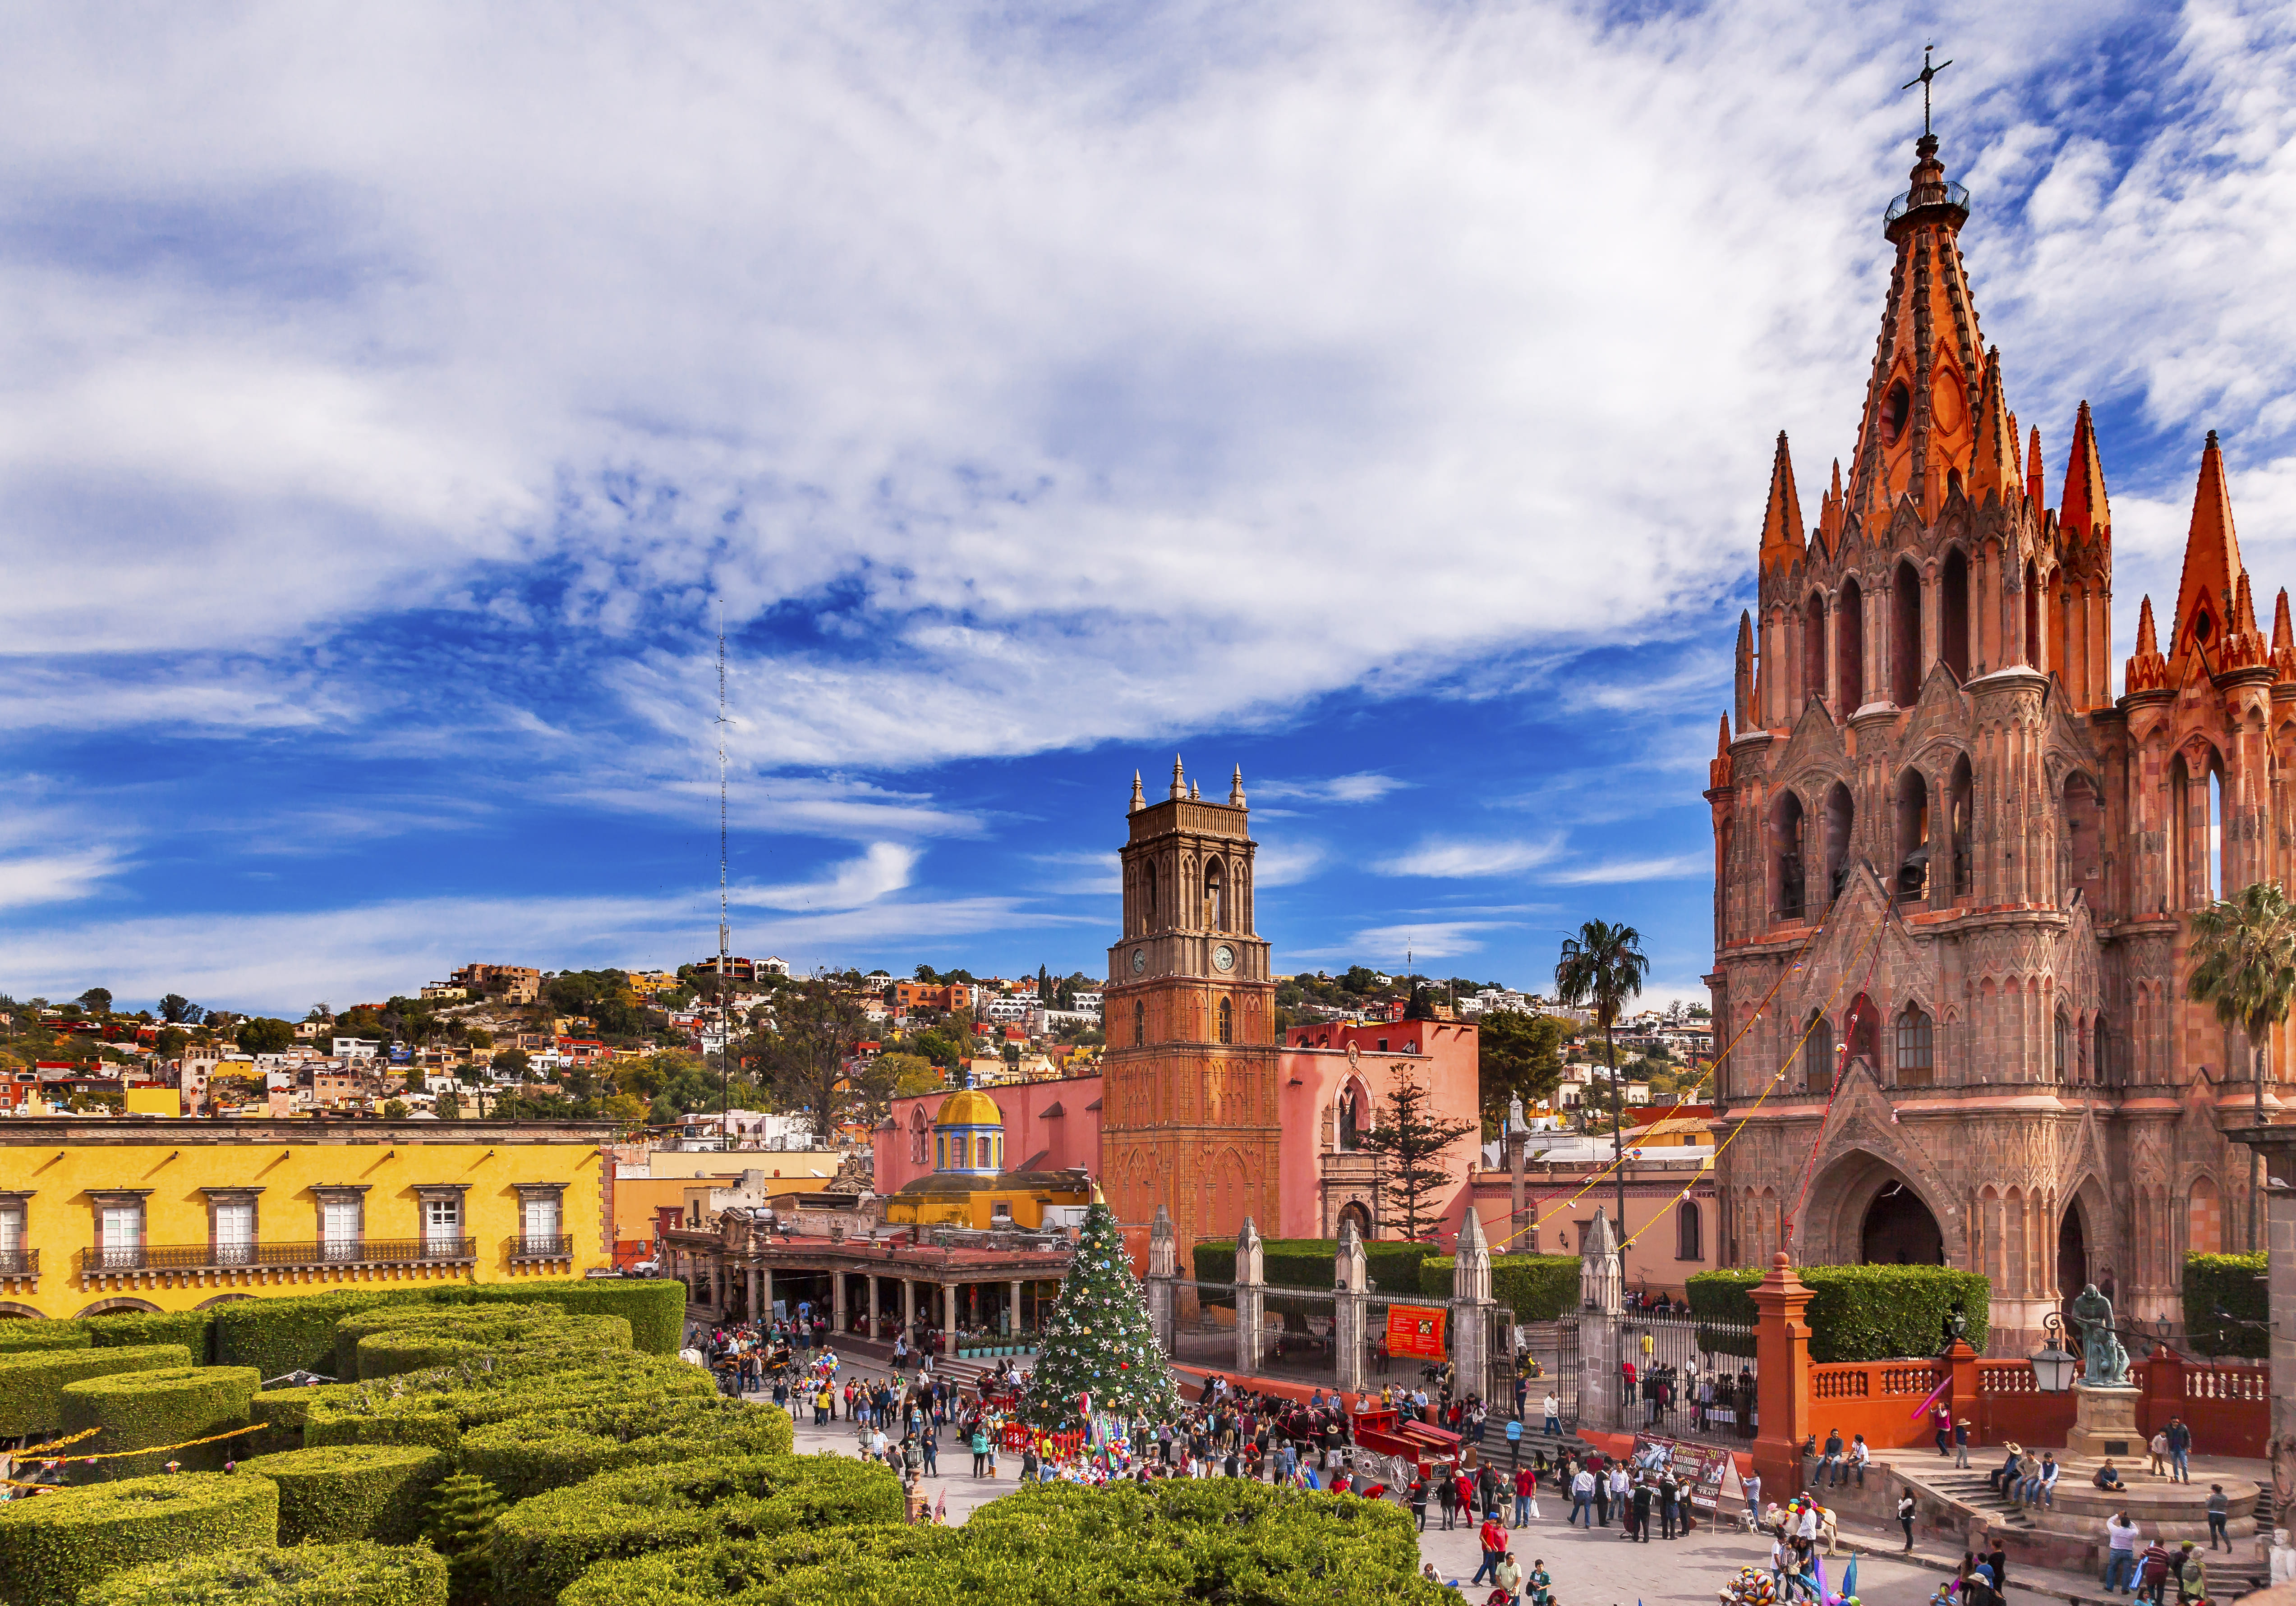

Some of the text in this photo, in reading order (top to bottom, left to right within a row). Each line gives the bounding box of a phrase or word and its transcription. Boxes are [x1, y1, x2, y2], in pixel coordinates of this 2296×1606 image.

[1706, 1449, 1717, 1459] 31
[1673, 1454, 1684, 1463] PACO
[1684, 1456, 1702, 1466] DODDOLI
[1672, 1463, 1686, 1474] MANOLO
[1697, 1488, 1718, 1497] "FRAN"
